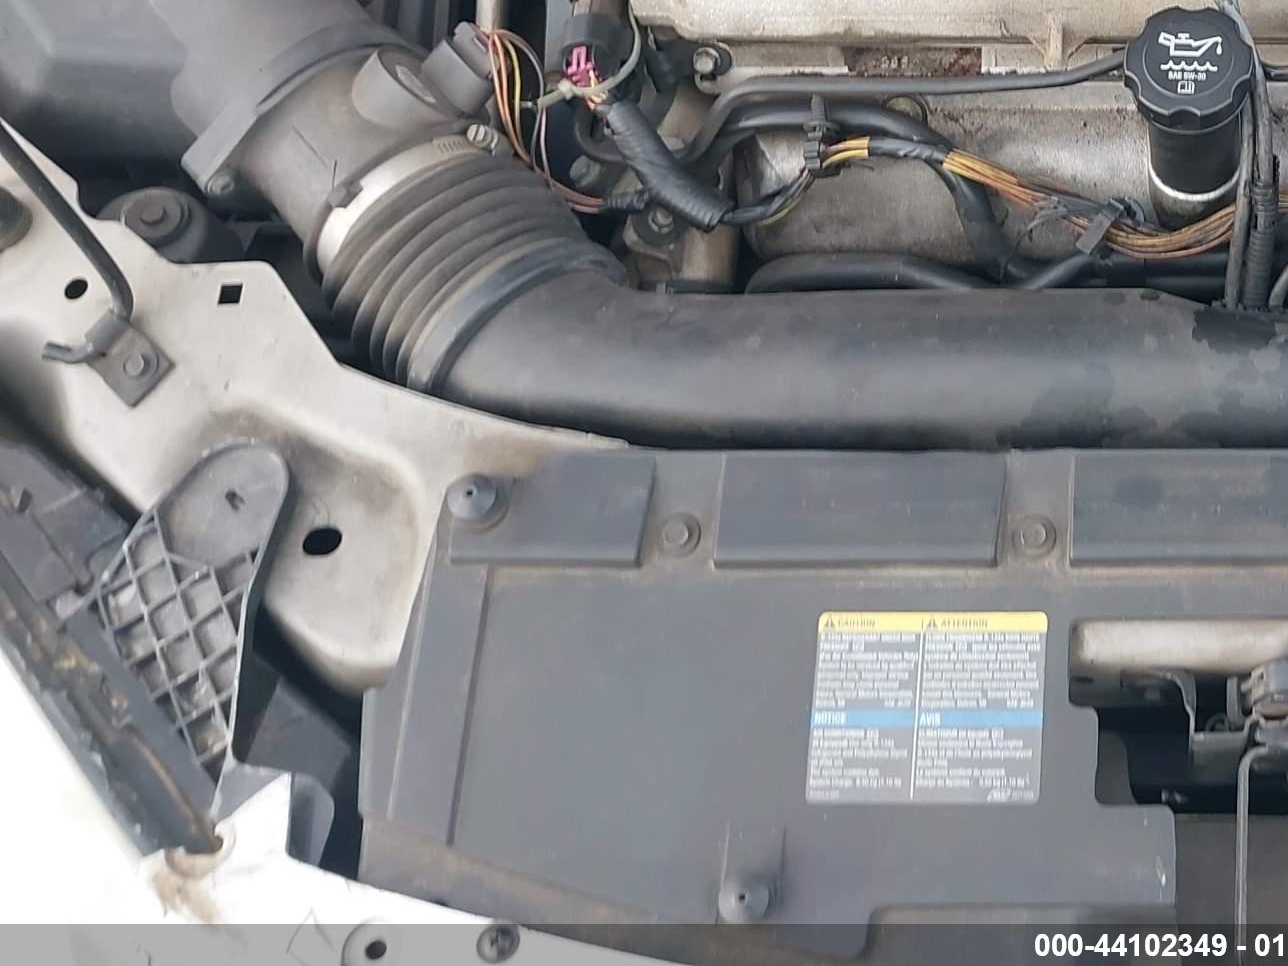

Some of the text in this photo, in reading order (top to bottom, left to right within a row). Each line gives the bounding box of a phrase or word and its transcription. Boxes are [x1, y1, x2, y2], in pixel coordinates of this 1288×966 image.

[838, 618, 876, 627] CAUTION
[941, 618, 988, 628] ATTENTION
[814, 712, 847, 724] NOTICE
[919, 713, 941, 726] AVIS
